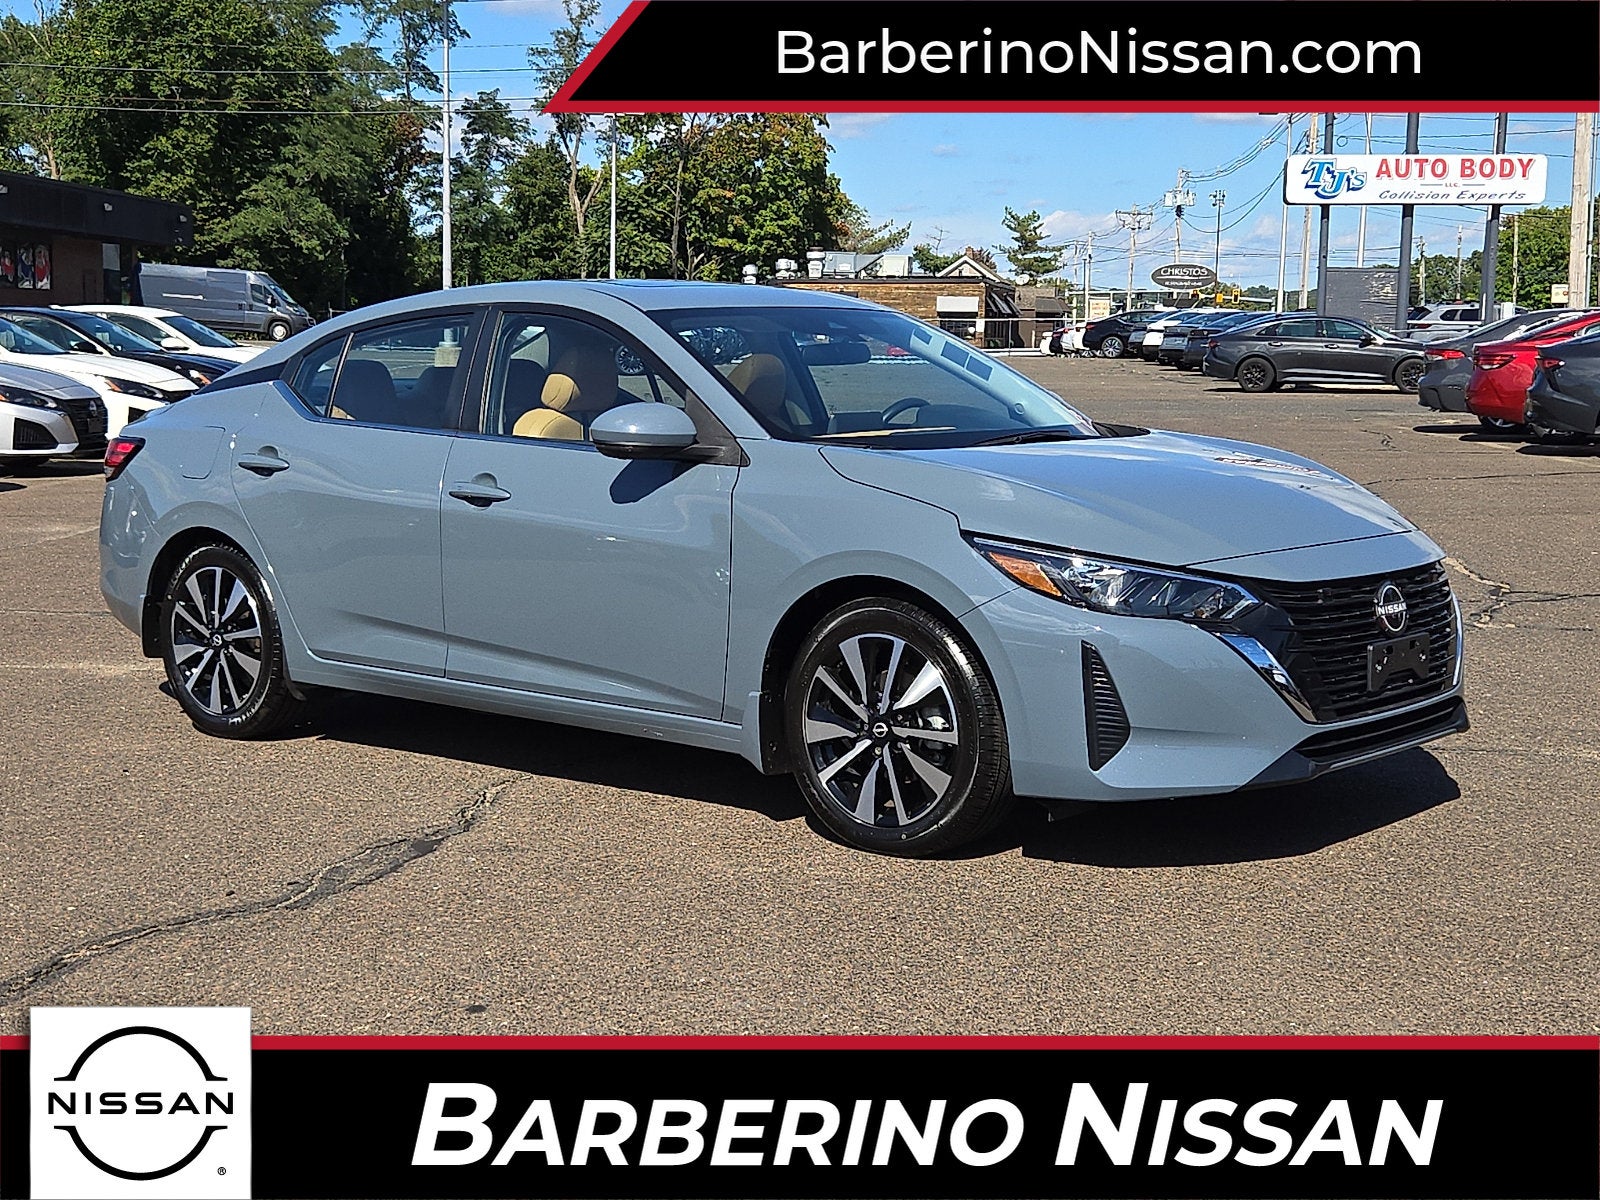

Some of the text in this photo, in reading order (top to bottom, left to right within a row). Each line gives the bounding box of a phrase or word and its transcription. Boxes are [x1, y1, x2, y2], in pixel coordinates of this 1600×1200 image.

[1376, 158, 1534, 179] AUTO BODY
[1379, 189, 1527, 202] Collision Experts
[1377, 602, 1407, 616] NISSAN
